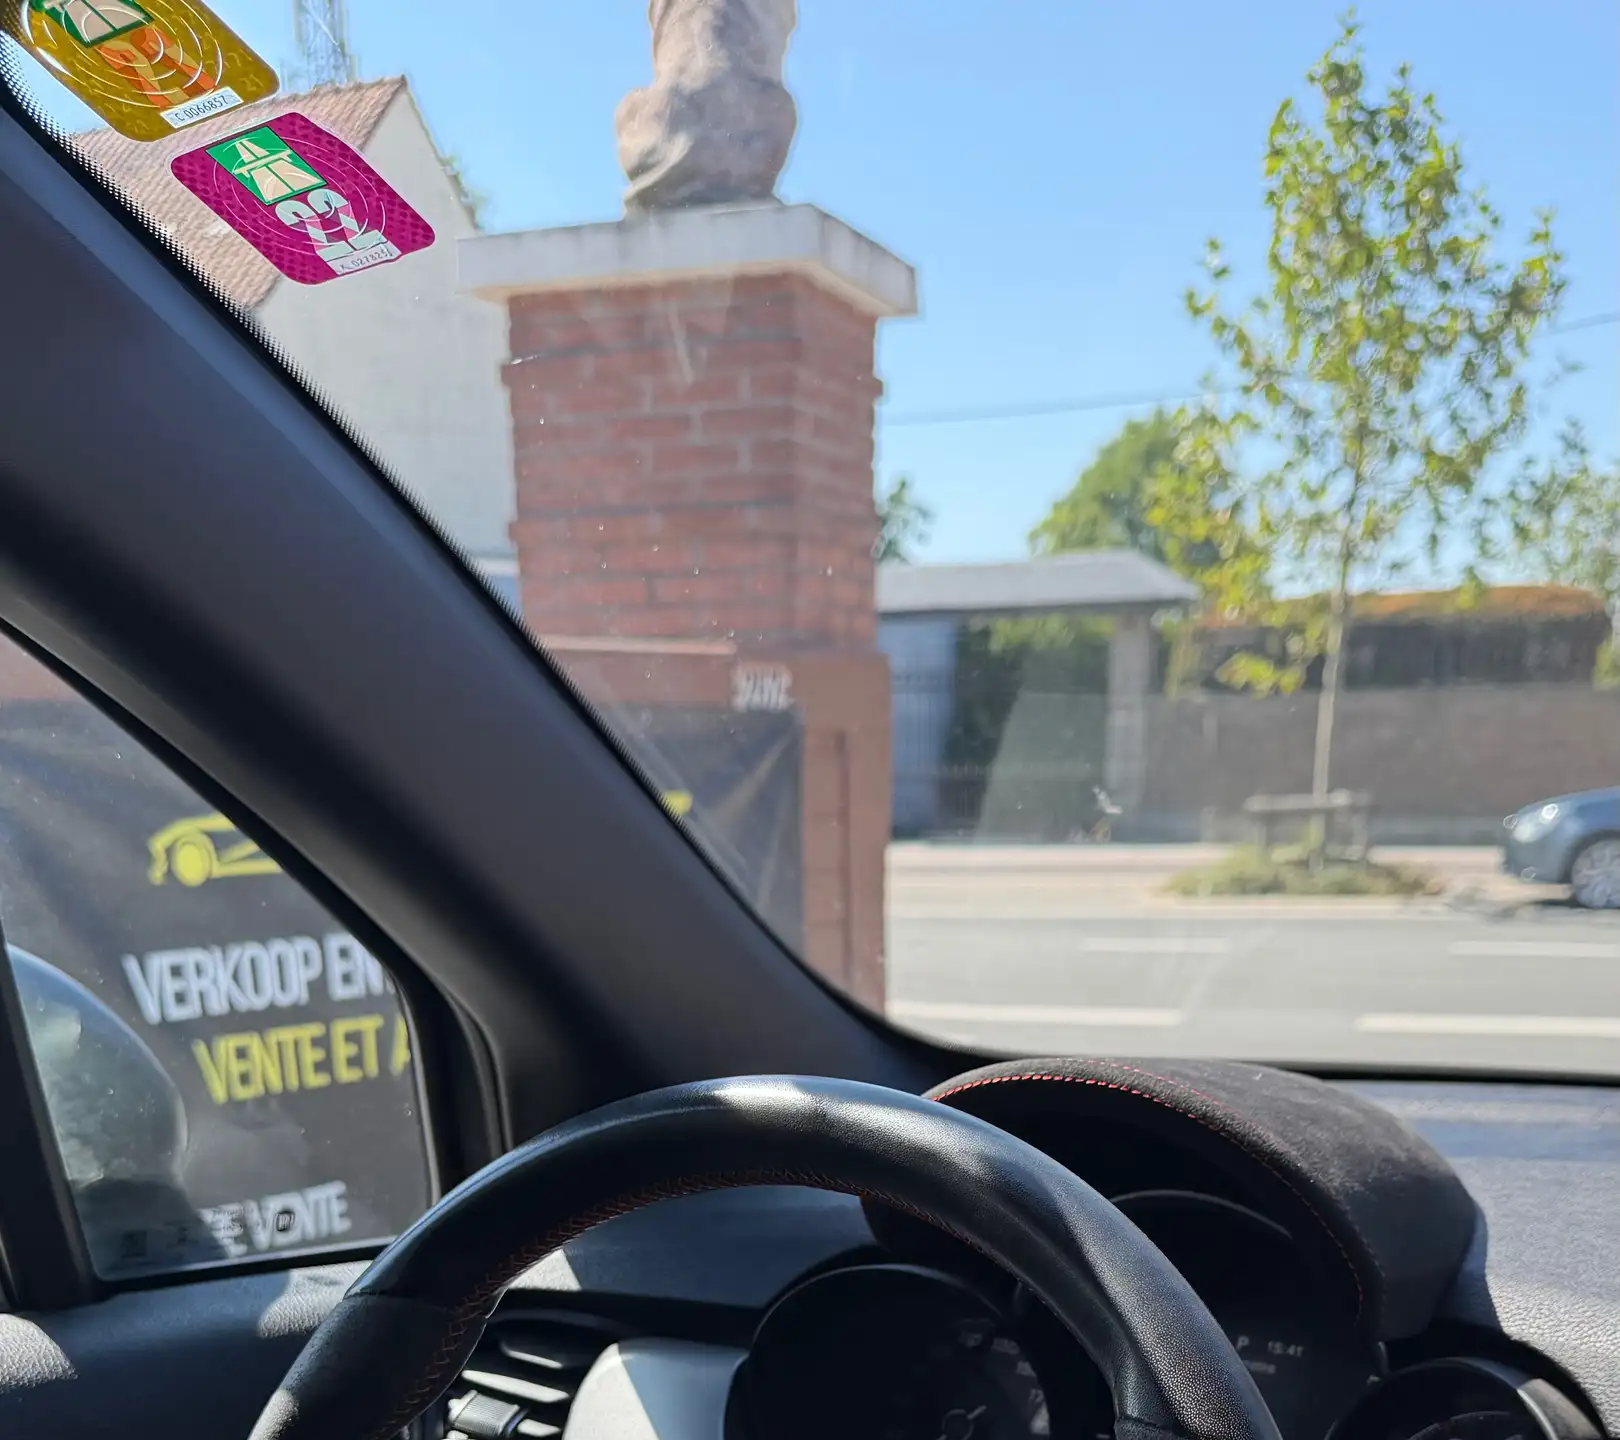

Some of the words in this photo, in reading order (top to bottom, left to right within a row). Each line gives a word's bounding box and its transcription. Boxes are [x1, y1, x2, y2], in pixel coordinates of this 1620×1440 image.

[122, 937, 323, 1025] VERKOOP
[192, 1021, 328, 1105] VENTE
[330, 1013, 384, 1085] ET
